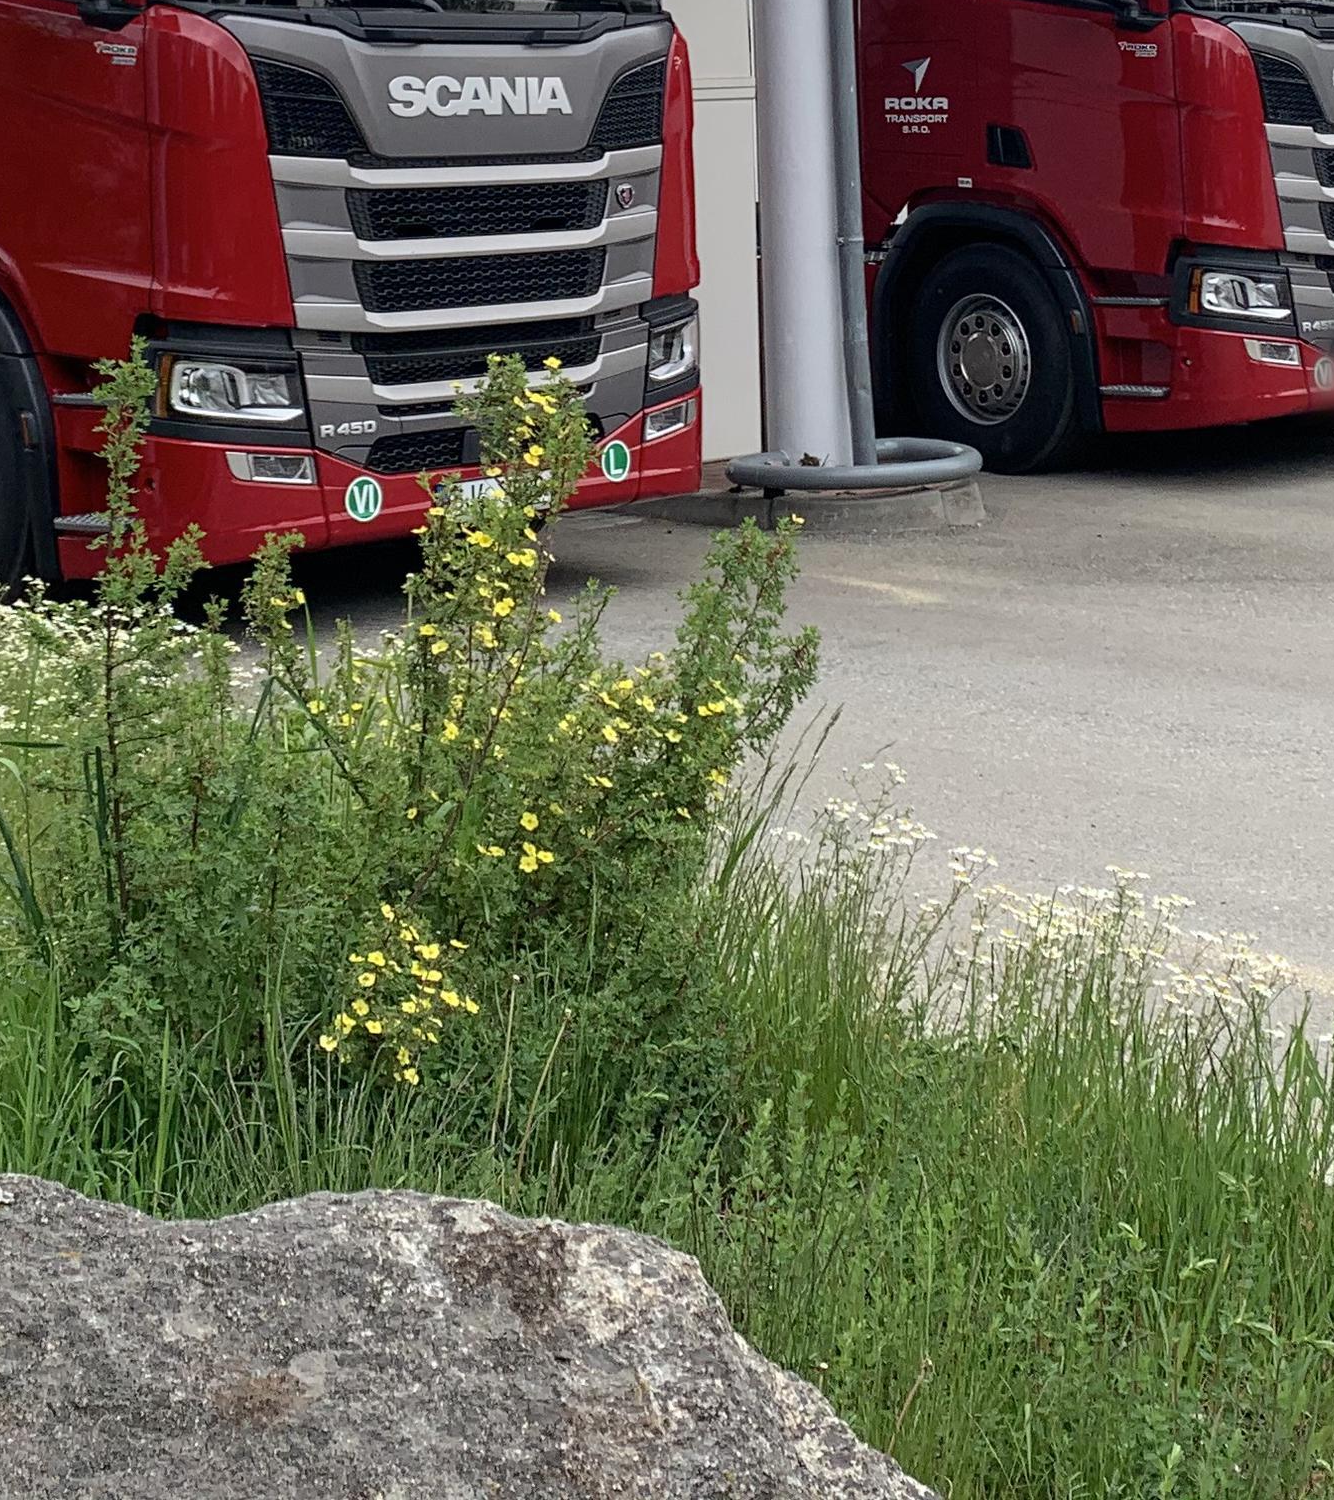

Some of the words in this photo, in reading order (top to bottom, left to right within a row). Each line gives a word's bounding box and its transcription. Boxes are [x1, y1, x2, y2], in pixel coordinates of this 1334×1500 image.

[387, 75, 573, 118] SCANIA
[884, 97, 949, 110] ROKA
[885, 114, 948, 123] TRANSPORT
[609, 449, 623, 475] L
